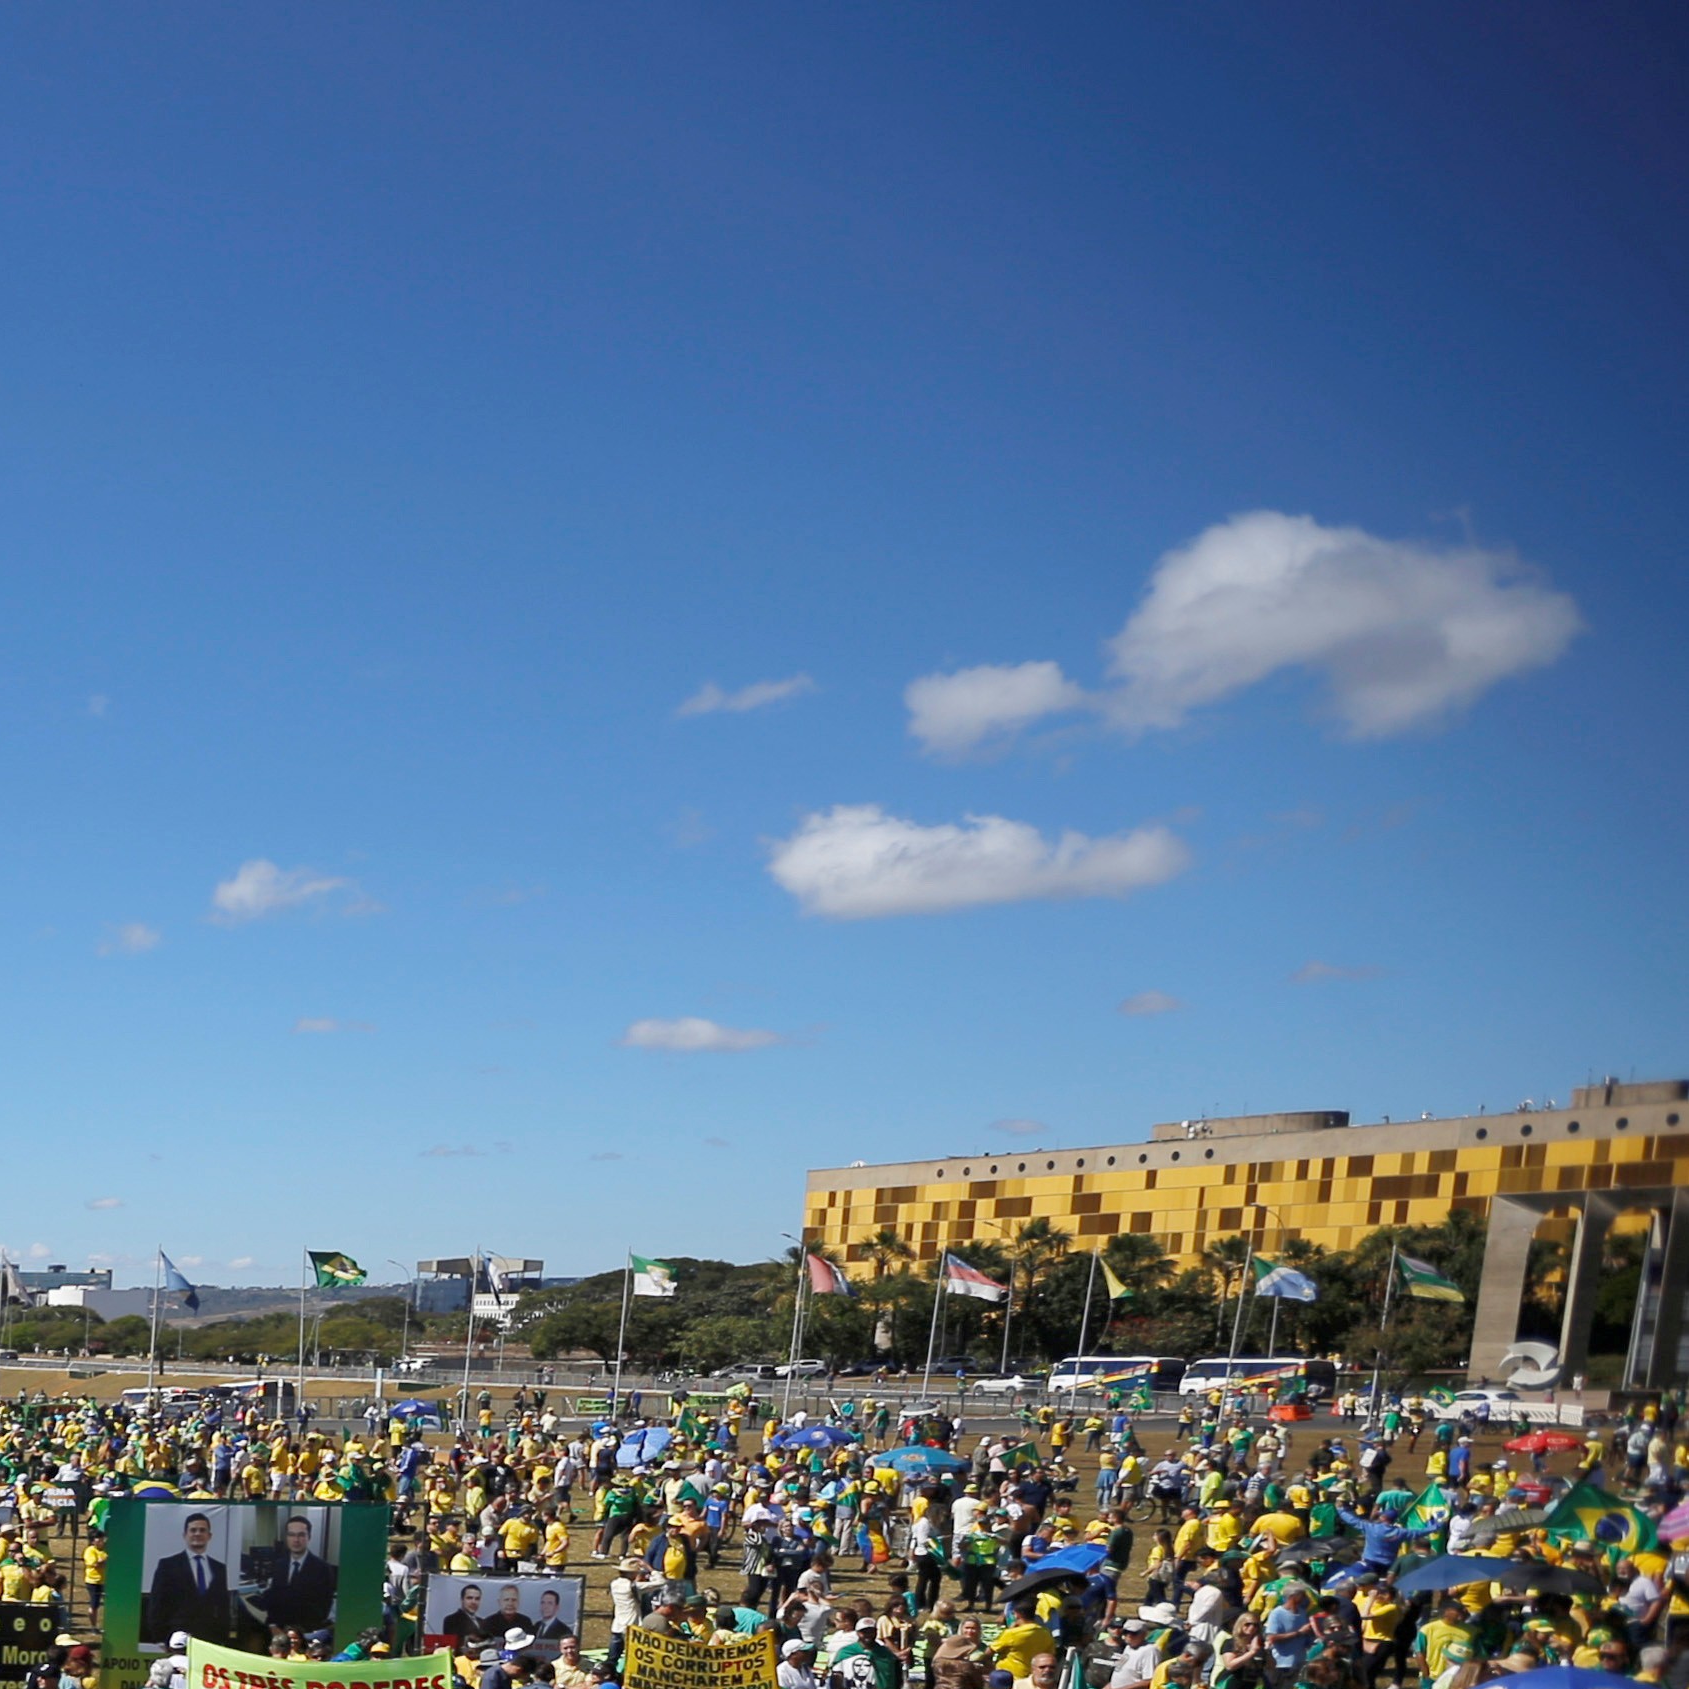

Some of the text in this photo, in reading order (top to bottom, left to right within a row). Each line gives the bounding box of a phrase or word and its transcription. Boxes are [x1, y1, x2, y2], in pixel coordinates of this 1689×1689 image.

[14, 1618, 26, 1631] e
[39, 1617, 53, 1632] o
[664, 1636, 768, 1660] DEIXAREMOS
[104, 1658, 142, 1672] APOIO
[634, 1648, 765, 1674] OS CORRUPTOS
[636, 1664, 761, 1688] MANCHAREM A
